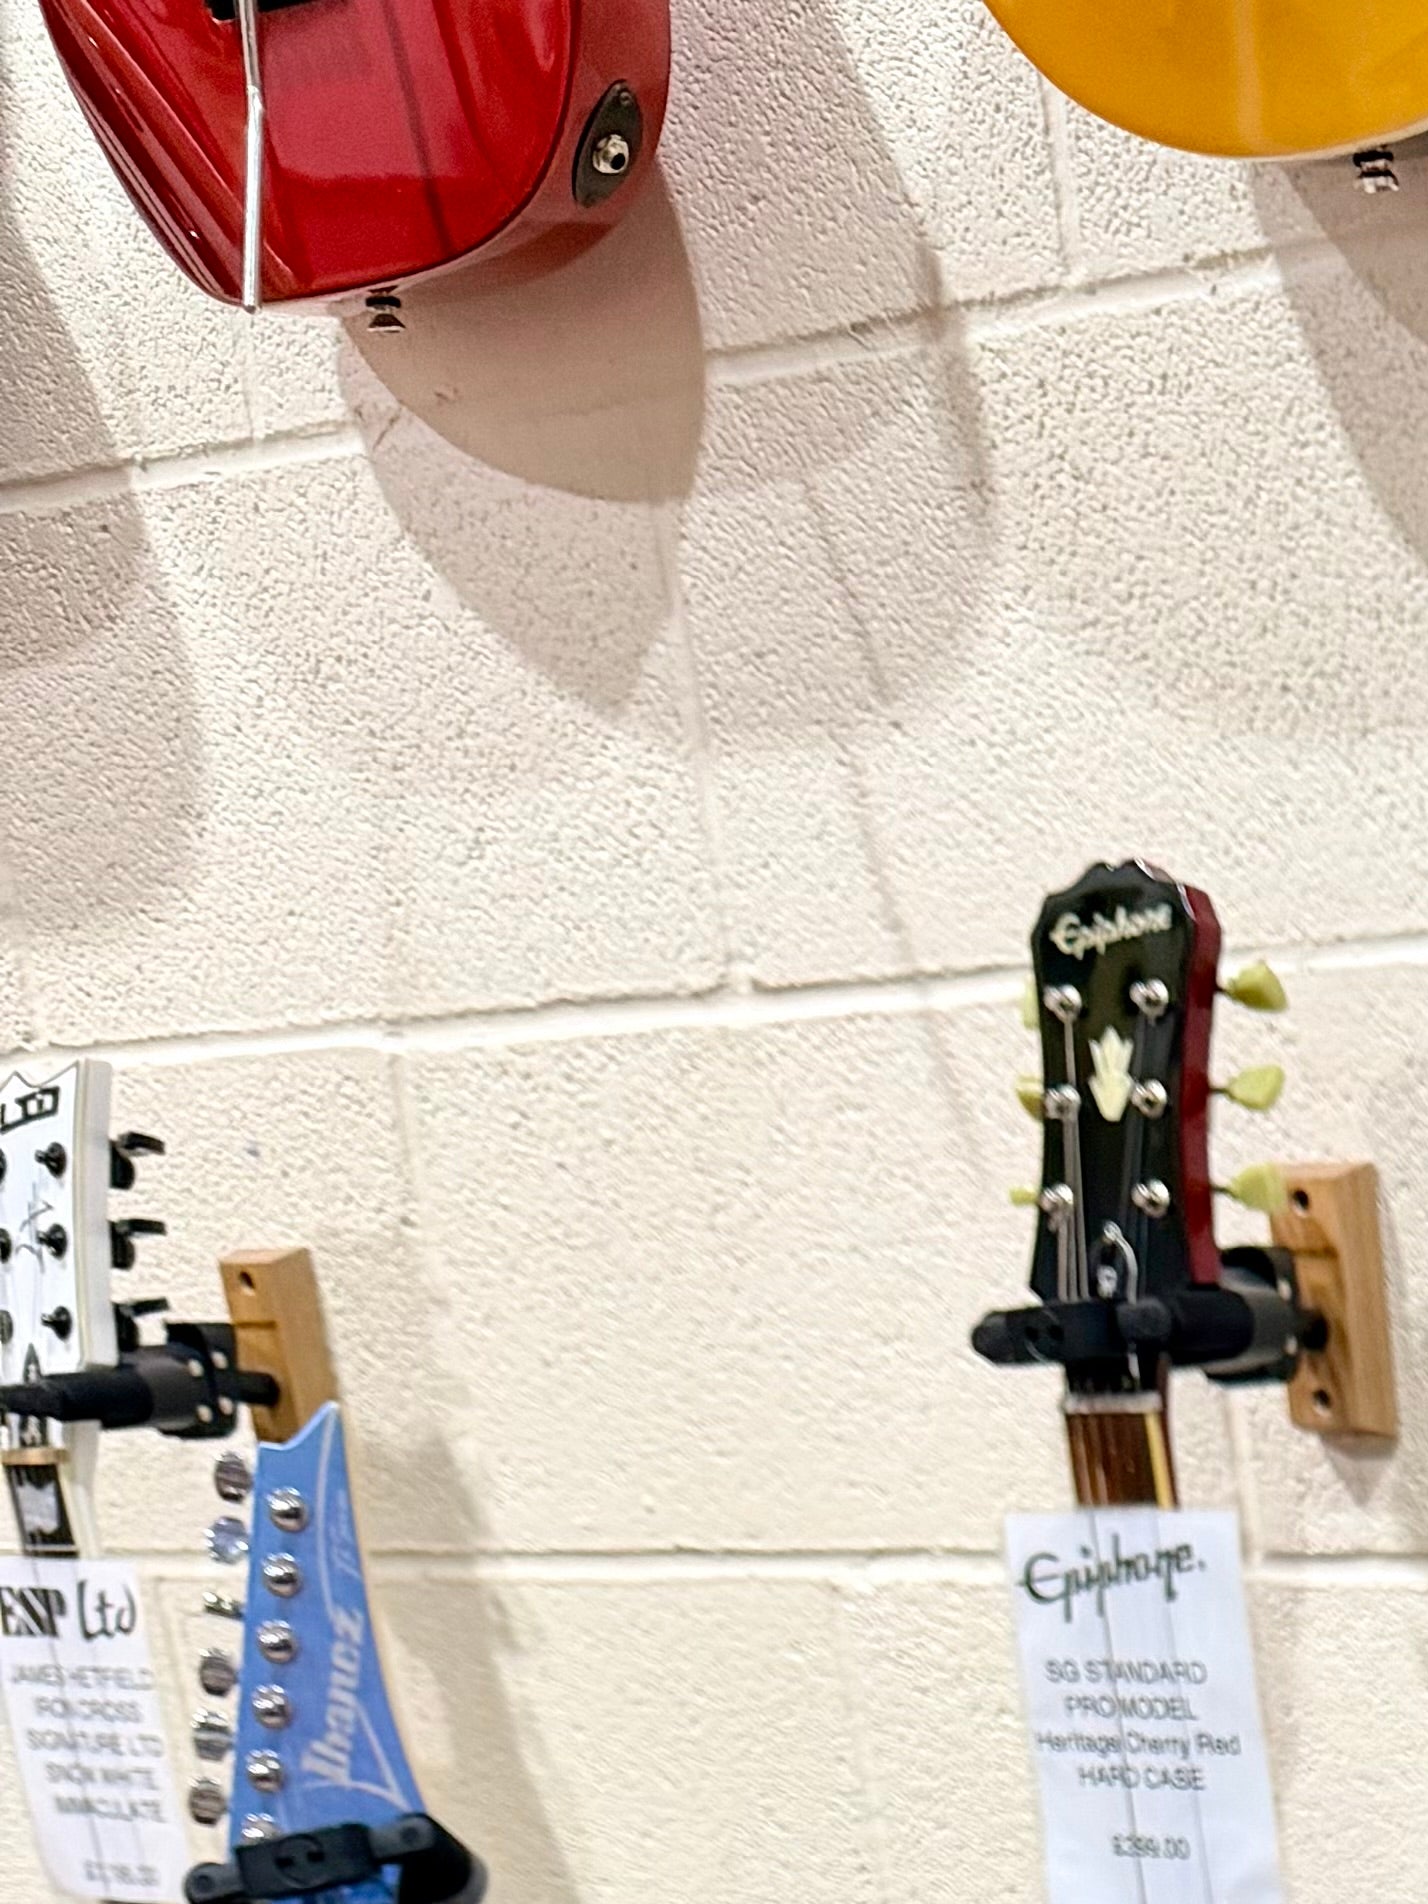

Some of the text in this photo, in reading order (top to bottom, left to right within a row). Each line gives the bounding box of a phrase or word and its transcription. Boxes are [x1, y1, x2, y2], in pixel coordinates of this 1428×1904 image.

[1050, 903, 1173, 961] Epiphone
[77, 1578, 138, 1641] Ltd
[1045, 1659, 1208, 1685] SG STANDARD
[302, 1607, 364, 1786] Ibanez
[1065, 1695, 1198, 1721] PRO MODEL
[1036, 1730, 1242, 1760] Heritage Cherry Red
[1077, 1766, 1206, 1791] HARD CASE
